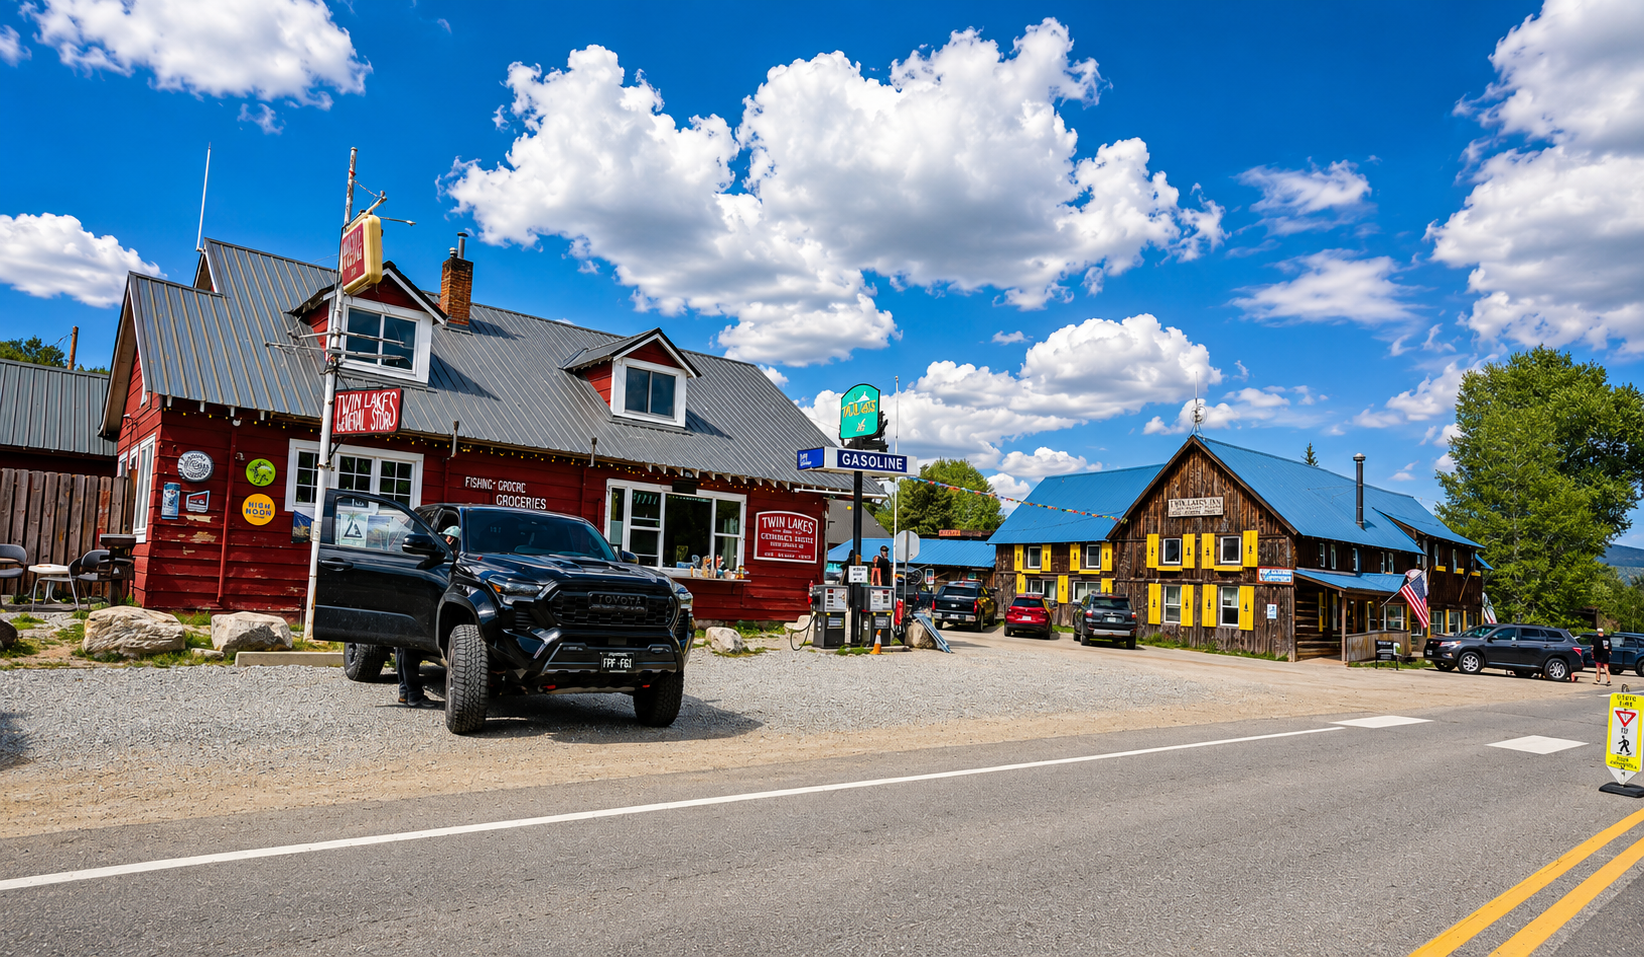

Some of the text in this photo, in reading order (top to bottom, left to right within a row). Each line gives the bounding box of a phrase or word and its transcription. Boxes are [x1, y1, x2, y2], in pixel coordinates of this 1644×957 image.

[842, 453, 903, 470] GASOLINE
[248, 501, 270, 509] HIGH
[245, 508, 272, 516] NOON
[761, 516, 814, 534] TWIN LAKES
[598, 595, 641, 605] TOYOTA
